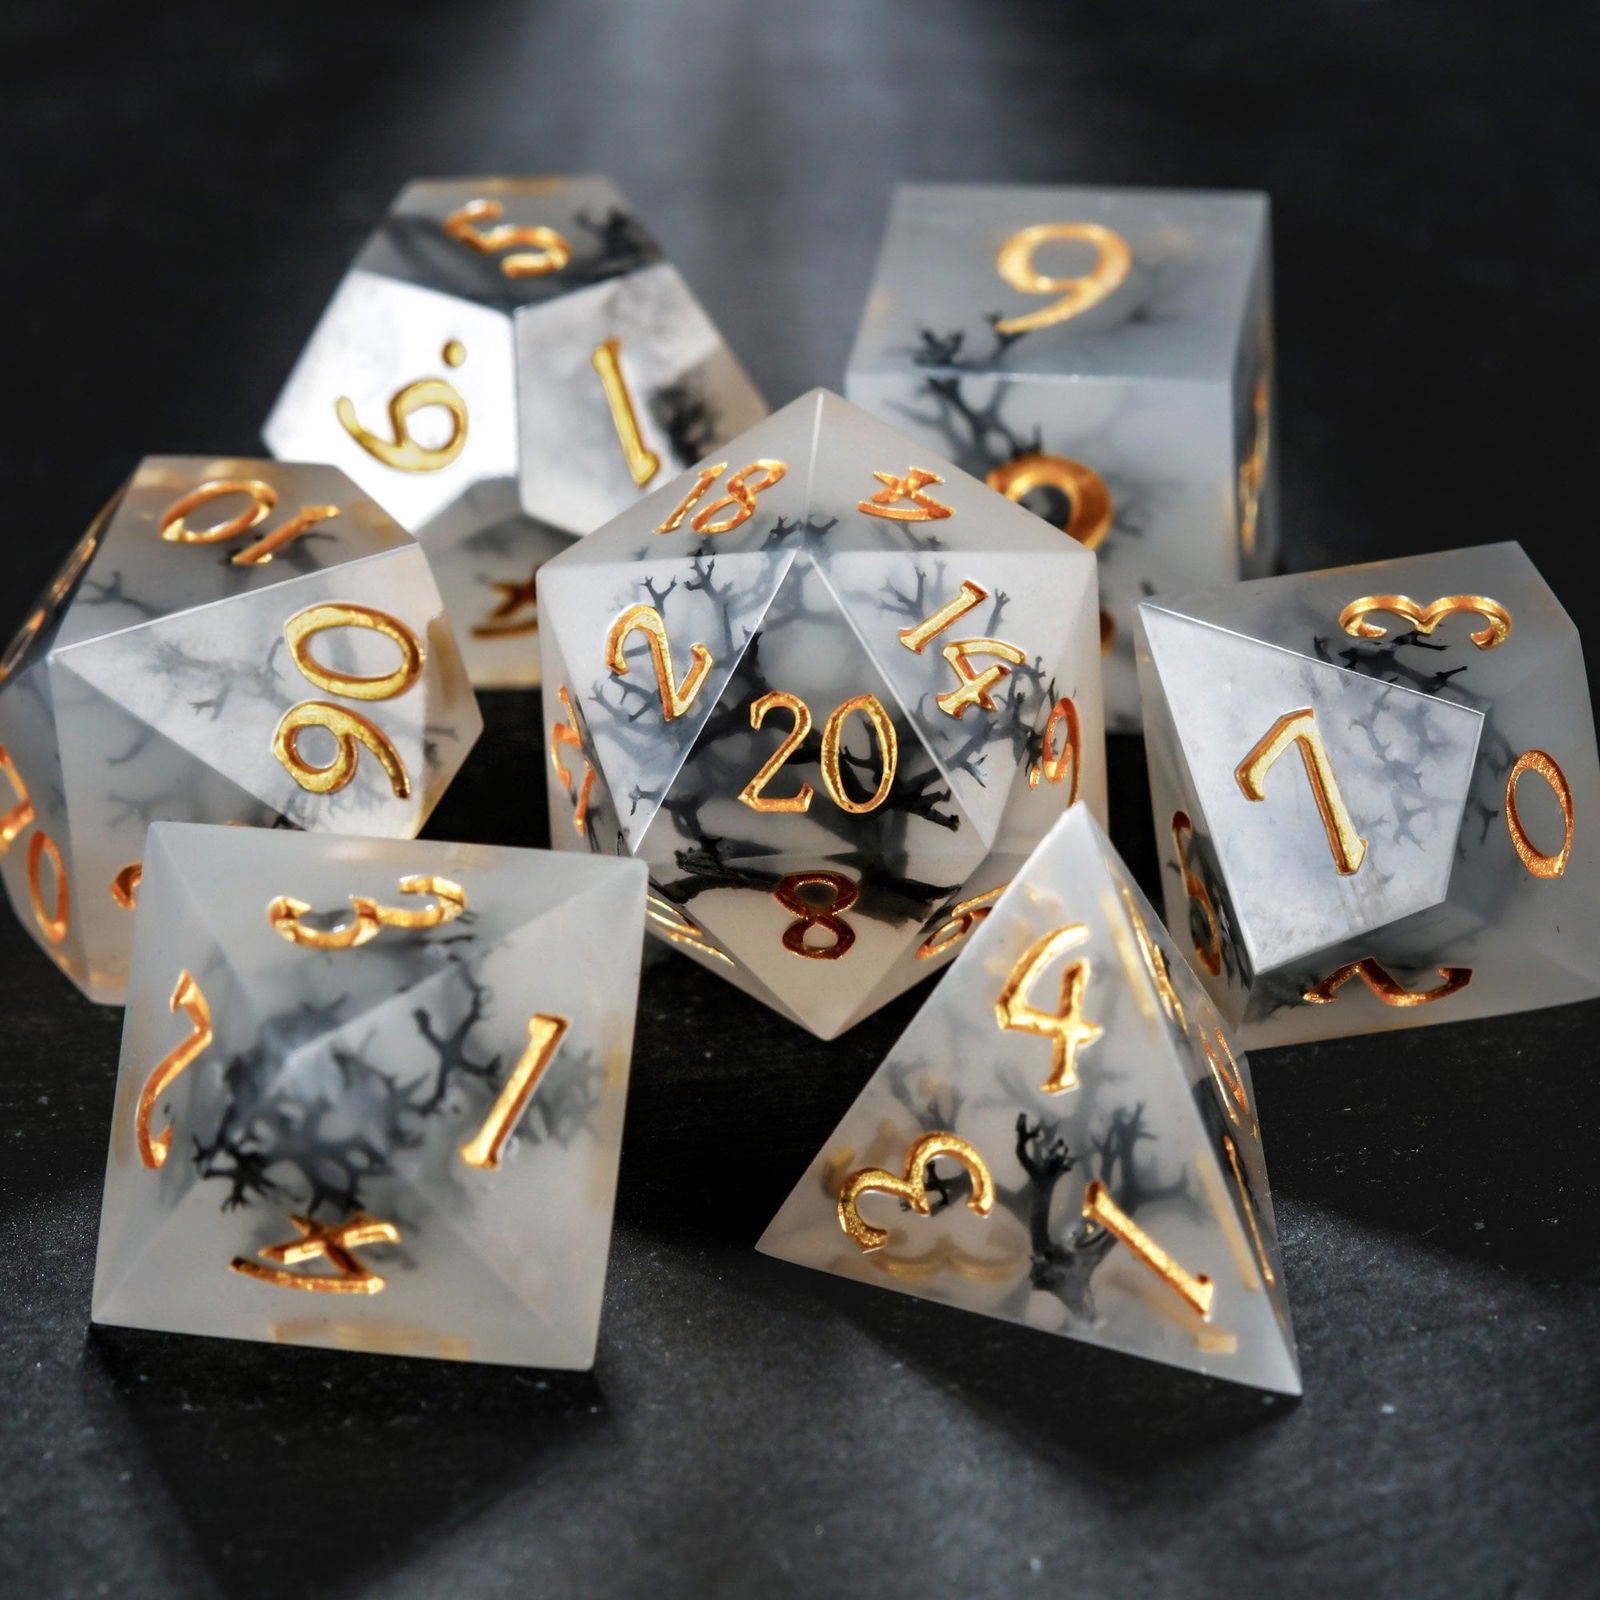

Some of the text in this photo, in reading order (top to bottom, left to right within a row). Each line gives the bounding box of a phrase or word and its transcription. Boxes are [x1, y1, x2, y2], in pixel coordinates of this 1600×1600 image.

[442, 198, 572, 278] 5
[592, 337, 660, 488] 1
[160, 479, 341, 566] 10
[653, 459, 788, 535] 18
[607, 604, 713, 723] 2
[899, 579, 1026, 720] 14
[1338, 594, 1513, 651] 3
[738, 692, 898, 815] 20
[1506, 749, 1576, 879] 0
[267, 874, 467, 950] 3
[774, 870, 858, 960] 8
[995, 922, 1104, 1096] 4
[461, 1012, 568, 1170] 1
[836, 1130, 995, 1254] 3
[1080, 1180, 1215, 1321] 1
[229, 1212, 399, 1295] 4
